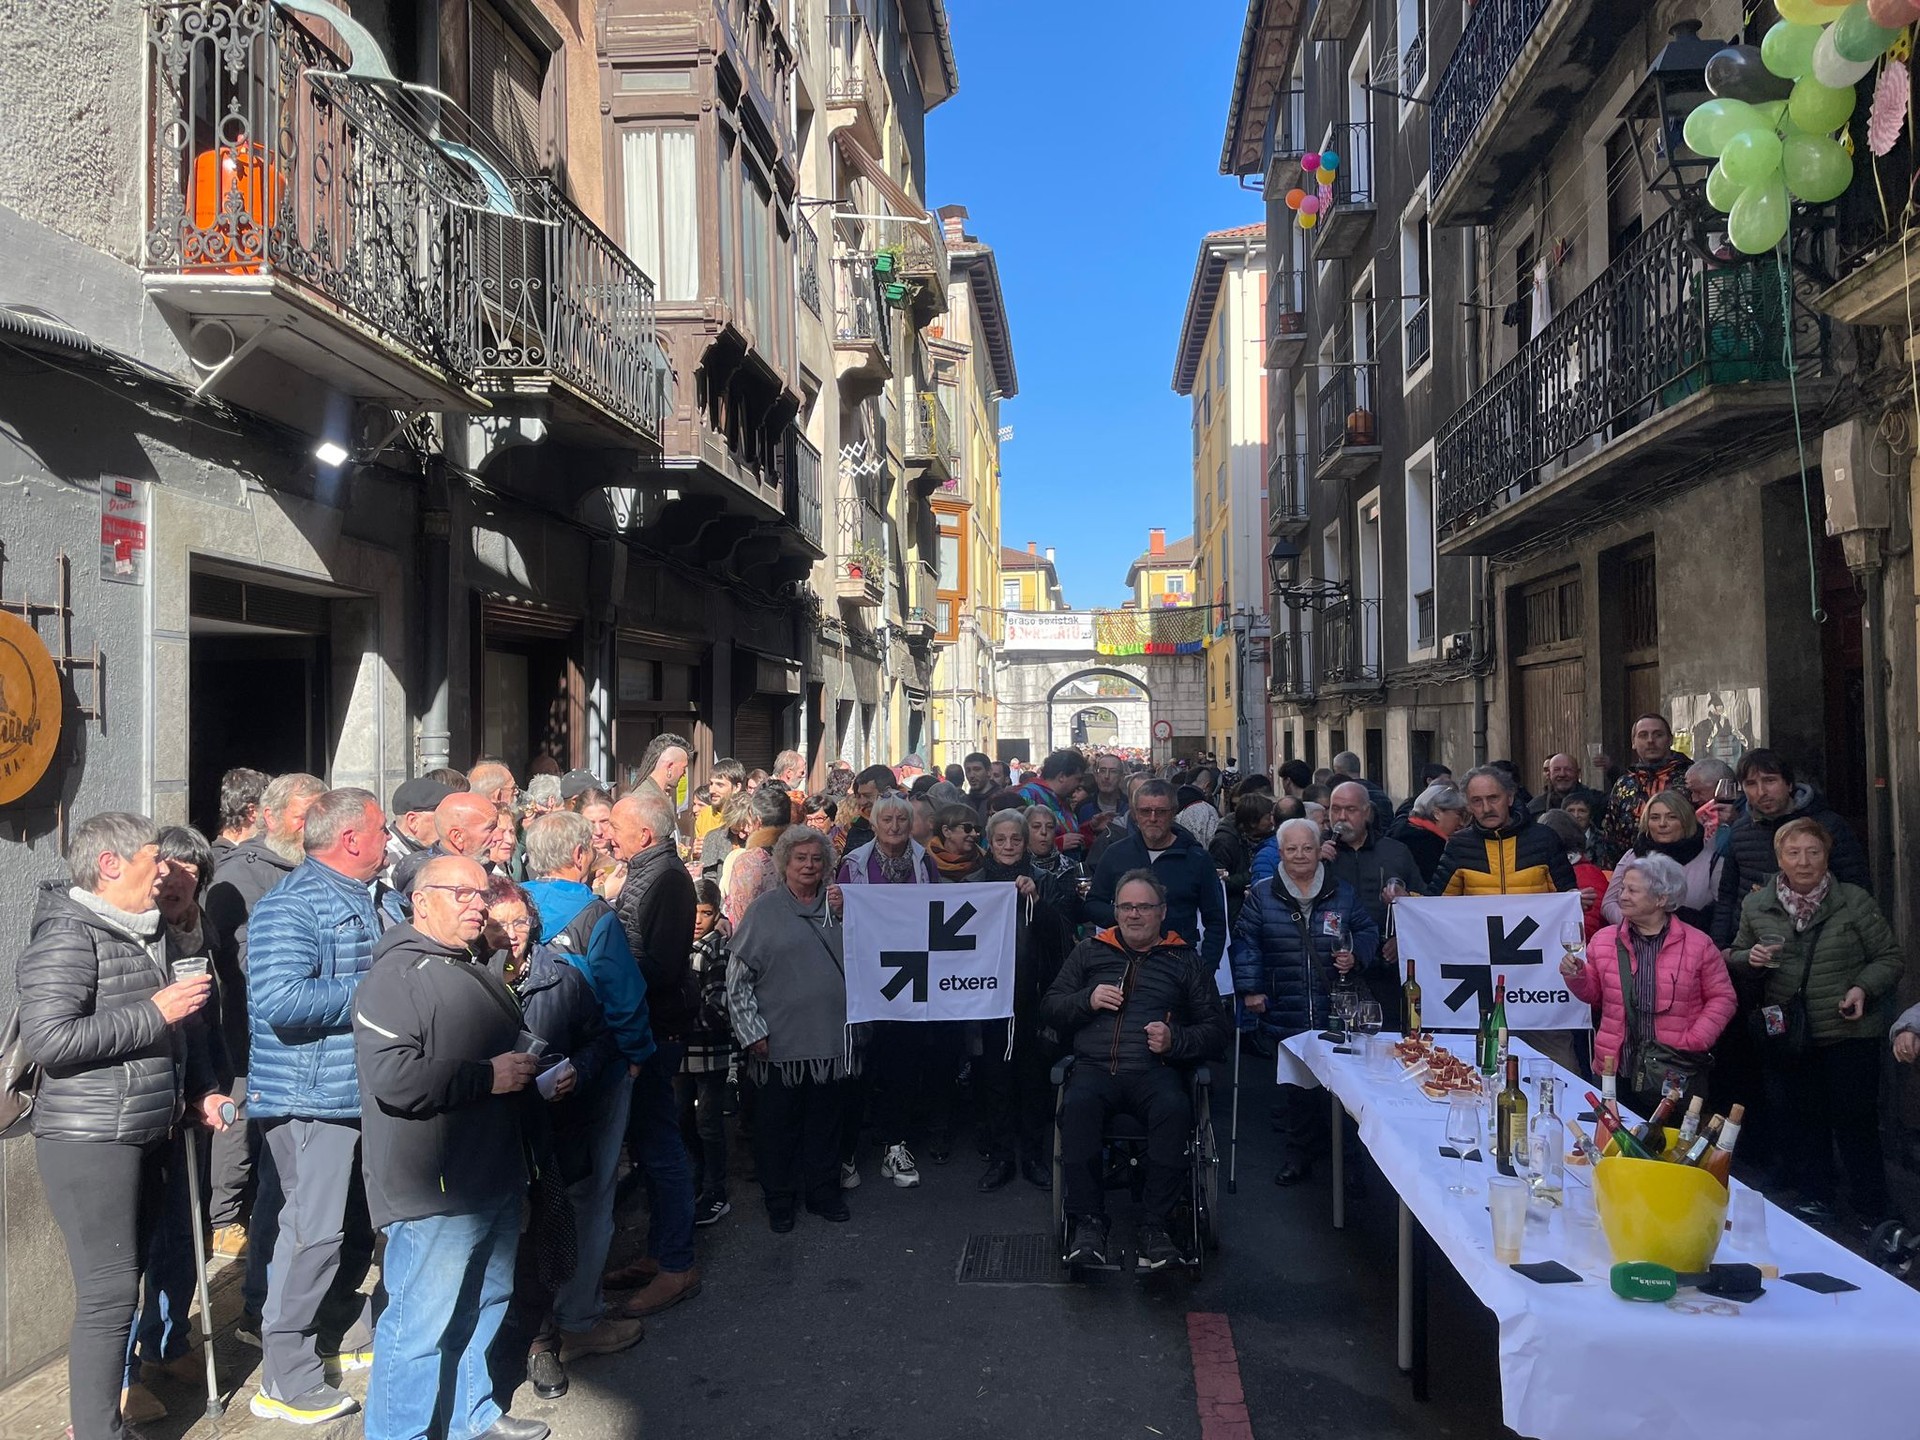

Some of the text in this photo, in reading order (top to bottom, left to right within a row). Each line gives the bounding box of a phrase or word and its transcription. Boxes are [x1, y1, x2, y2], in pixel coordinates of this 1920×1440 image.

[1008, 617, 1036, 625] eraso
[939, 974, 998, 991] etxera
[1506, 988, 1570, 1004] etxera
